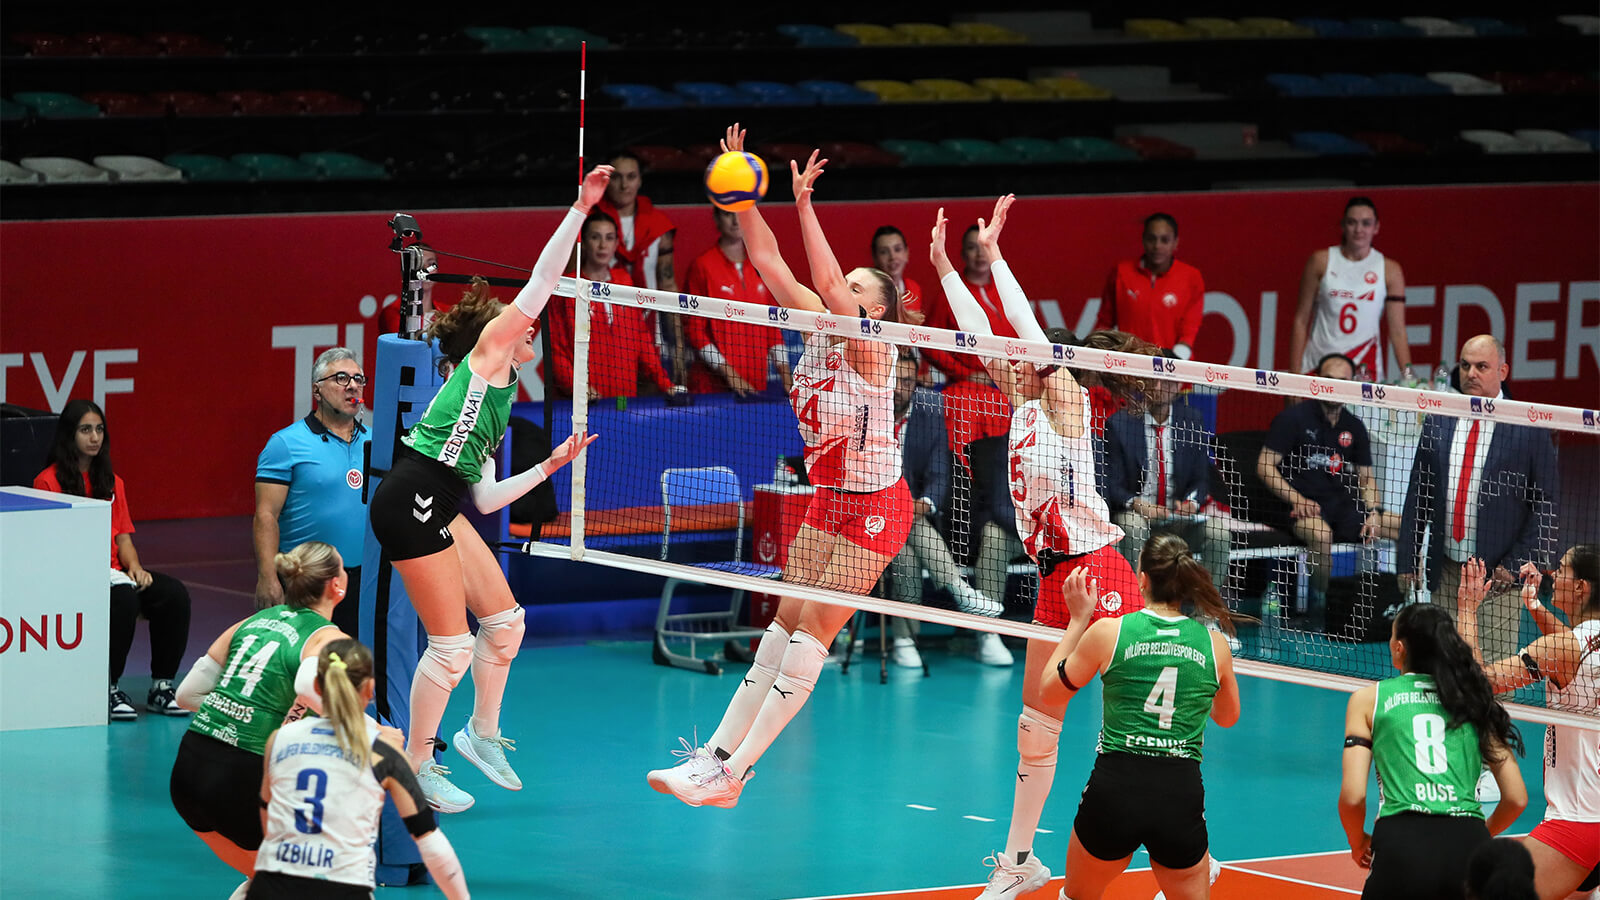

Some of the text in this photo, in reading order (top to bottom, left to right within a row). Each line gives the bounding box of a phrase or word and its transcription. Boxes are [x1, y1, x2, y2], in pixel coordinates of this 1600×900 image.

[645, 295, 656, 304] TVF
[733, 308, 744, 316] TVF
[1339, 302, 1358, 335] 6
[825, 320, 836, 329] TVF
[918, 333, 931, 342] TVF
[1015, 347, 1027, 355] TVF
[1114, 359, 1126, 368] TVF
[1215, 372, 1229, 381] TVF
[1320, 385, 1334, 394] TVF
[1428, 399, 1442, 408] TVF
[1539, 412, 1552, 421] TVF
[442, 399, 482, 465] MEDICANA
[439, 526, 450, 539] 11
[220, 634, 281, 697] 14
[1144, 666, 1179, 730] 4
[204, 692, 255, 724] DWARDS
[1412, 713, 1448, 774] 8
[1415, 782, 1458, 802] BUSE
[294, 768, 328, 834] 3
[275, 839, 335, 869] İZBİLİR
